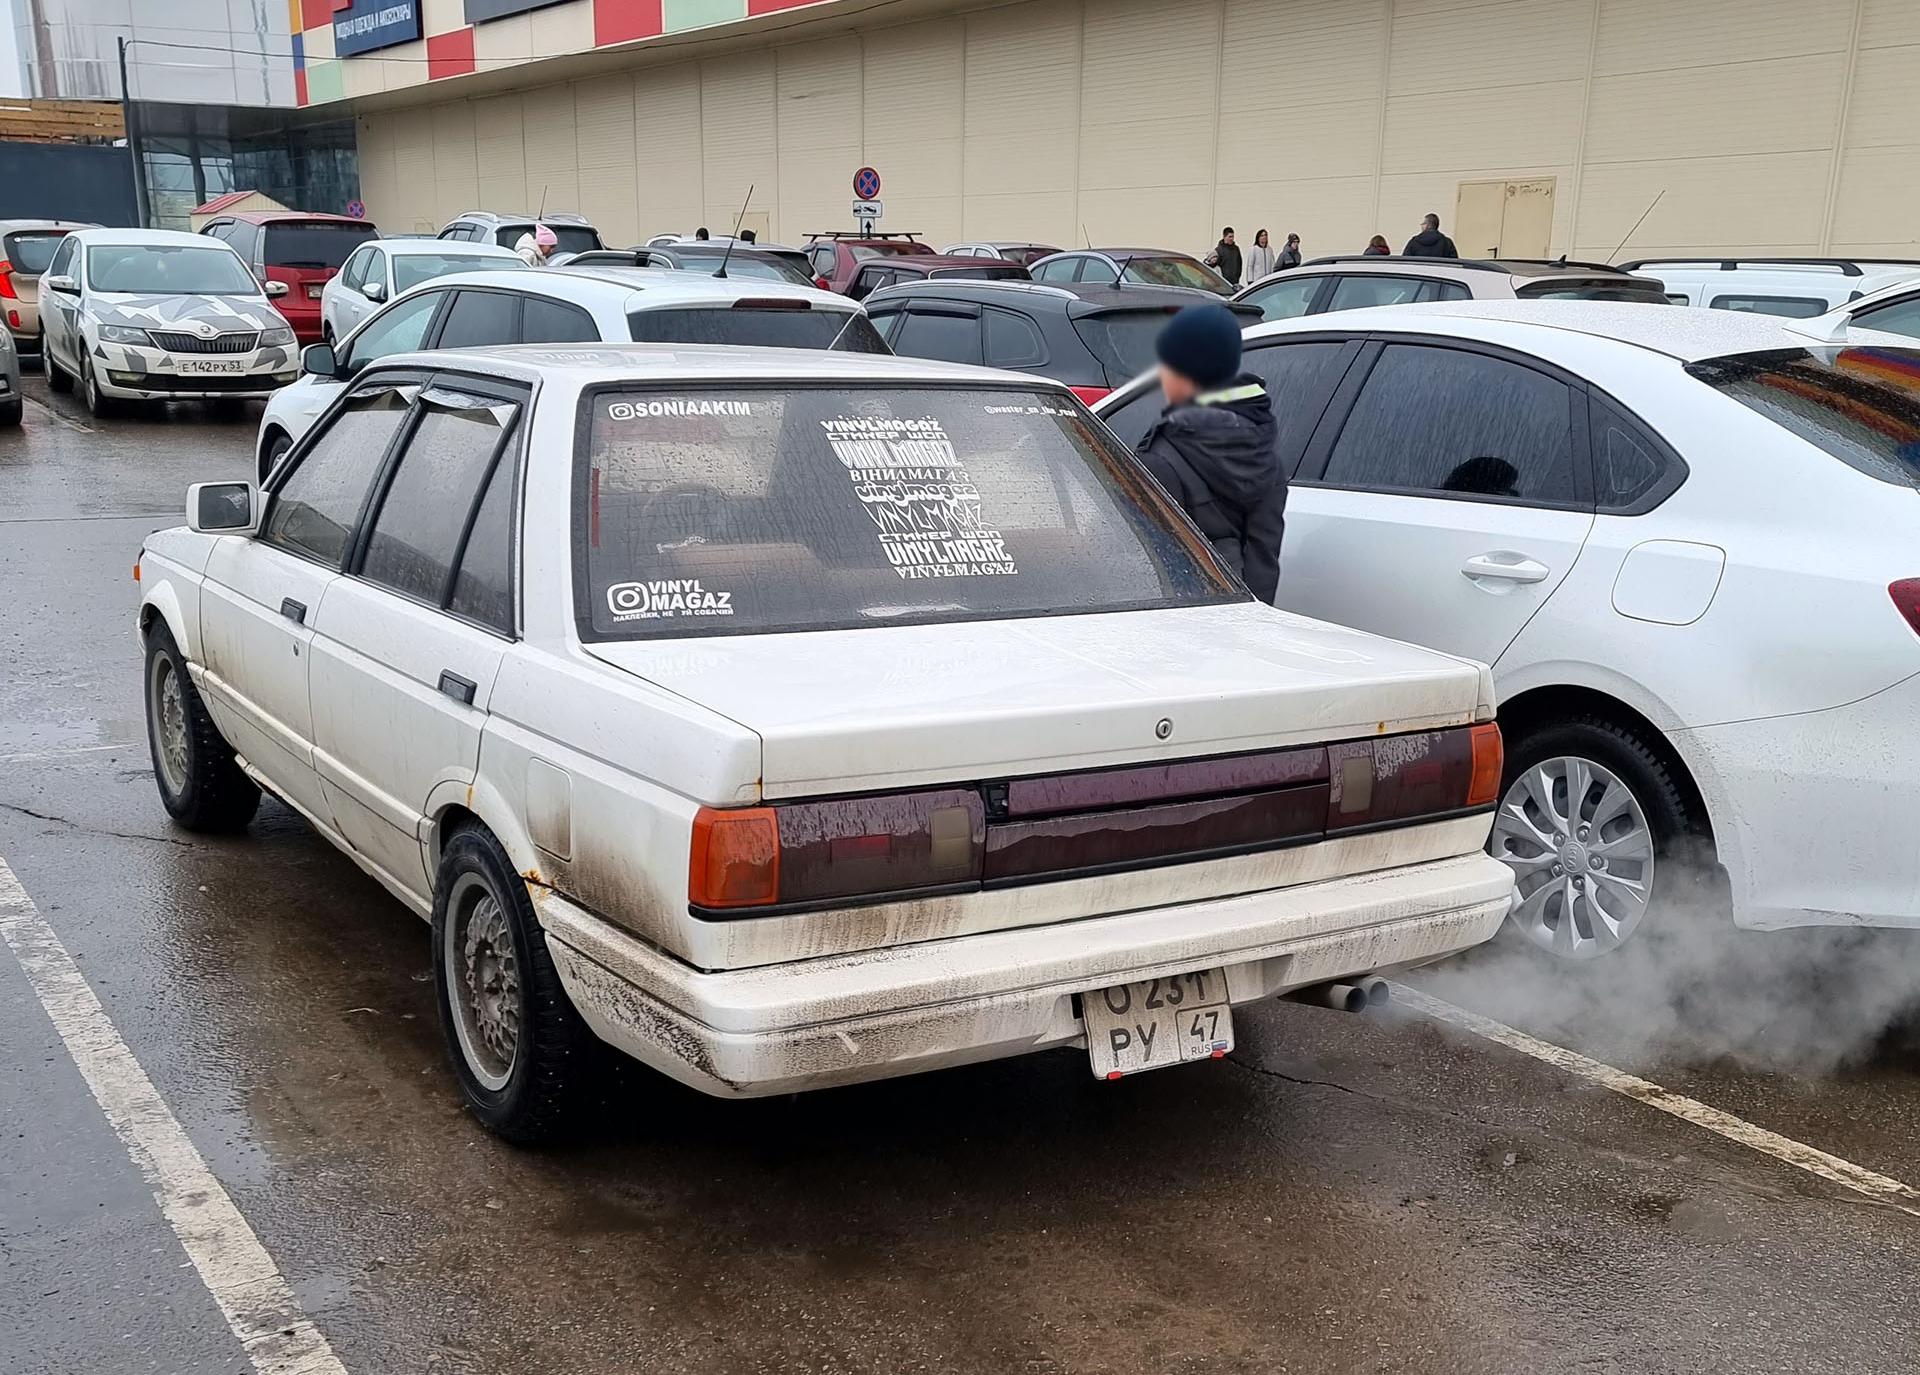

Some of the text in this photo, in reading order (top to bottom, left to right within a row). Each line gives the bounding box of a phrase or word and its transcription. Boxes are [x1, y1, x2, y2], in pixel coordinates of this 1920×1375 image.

[230, 360, 241, 370] 53
[635, 401, 751, 417] SONIAAKIM
[820, 417, 943, 432] VINYLMAGAZ
[826, 431, 949, 441] СТИКЕР ШОП
[831, 440, 964, 469] VINYLMAGAZ
[862, 502, 995, 533] VINYLMAGAZ
[878, 530, 1002, 542] СТИКЕР ШОП
[882, 539, 1014, 565] VINYLMAGAZ
[895, 562, 1018, 579] VINYLMAGAZ
[648, 579, 704, 594] VINYL
[651, 592, 731, 610] MAGAZ
[662, 610, 674, 618] НЕ
[1109, 1010, 1219, 1068] РУ 47
[1191, 1045, 1211, 1056] RUS
